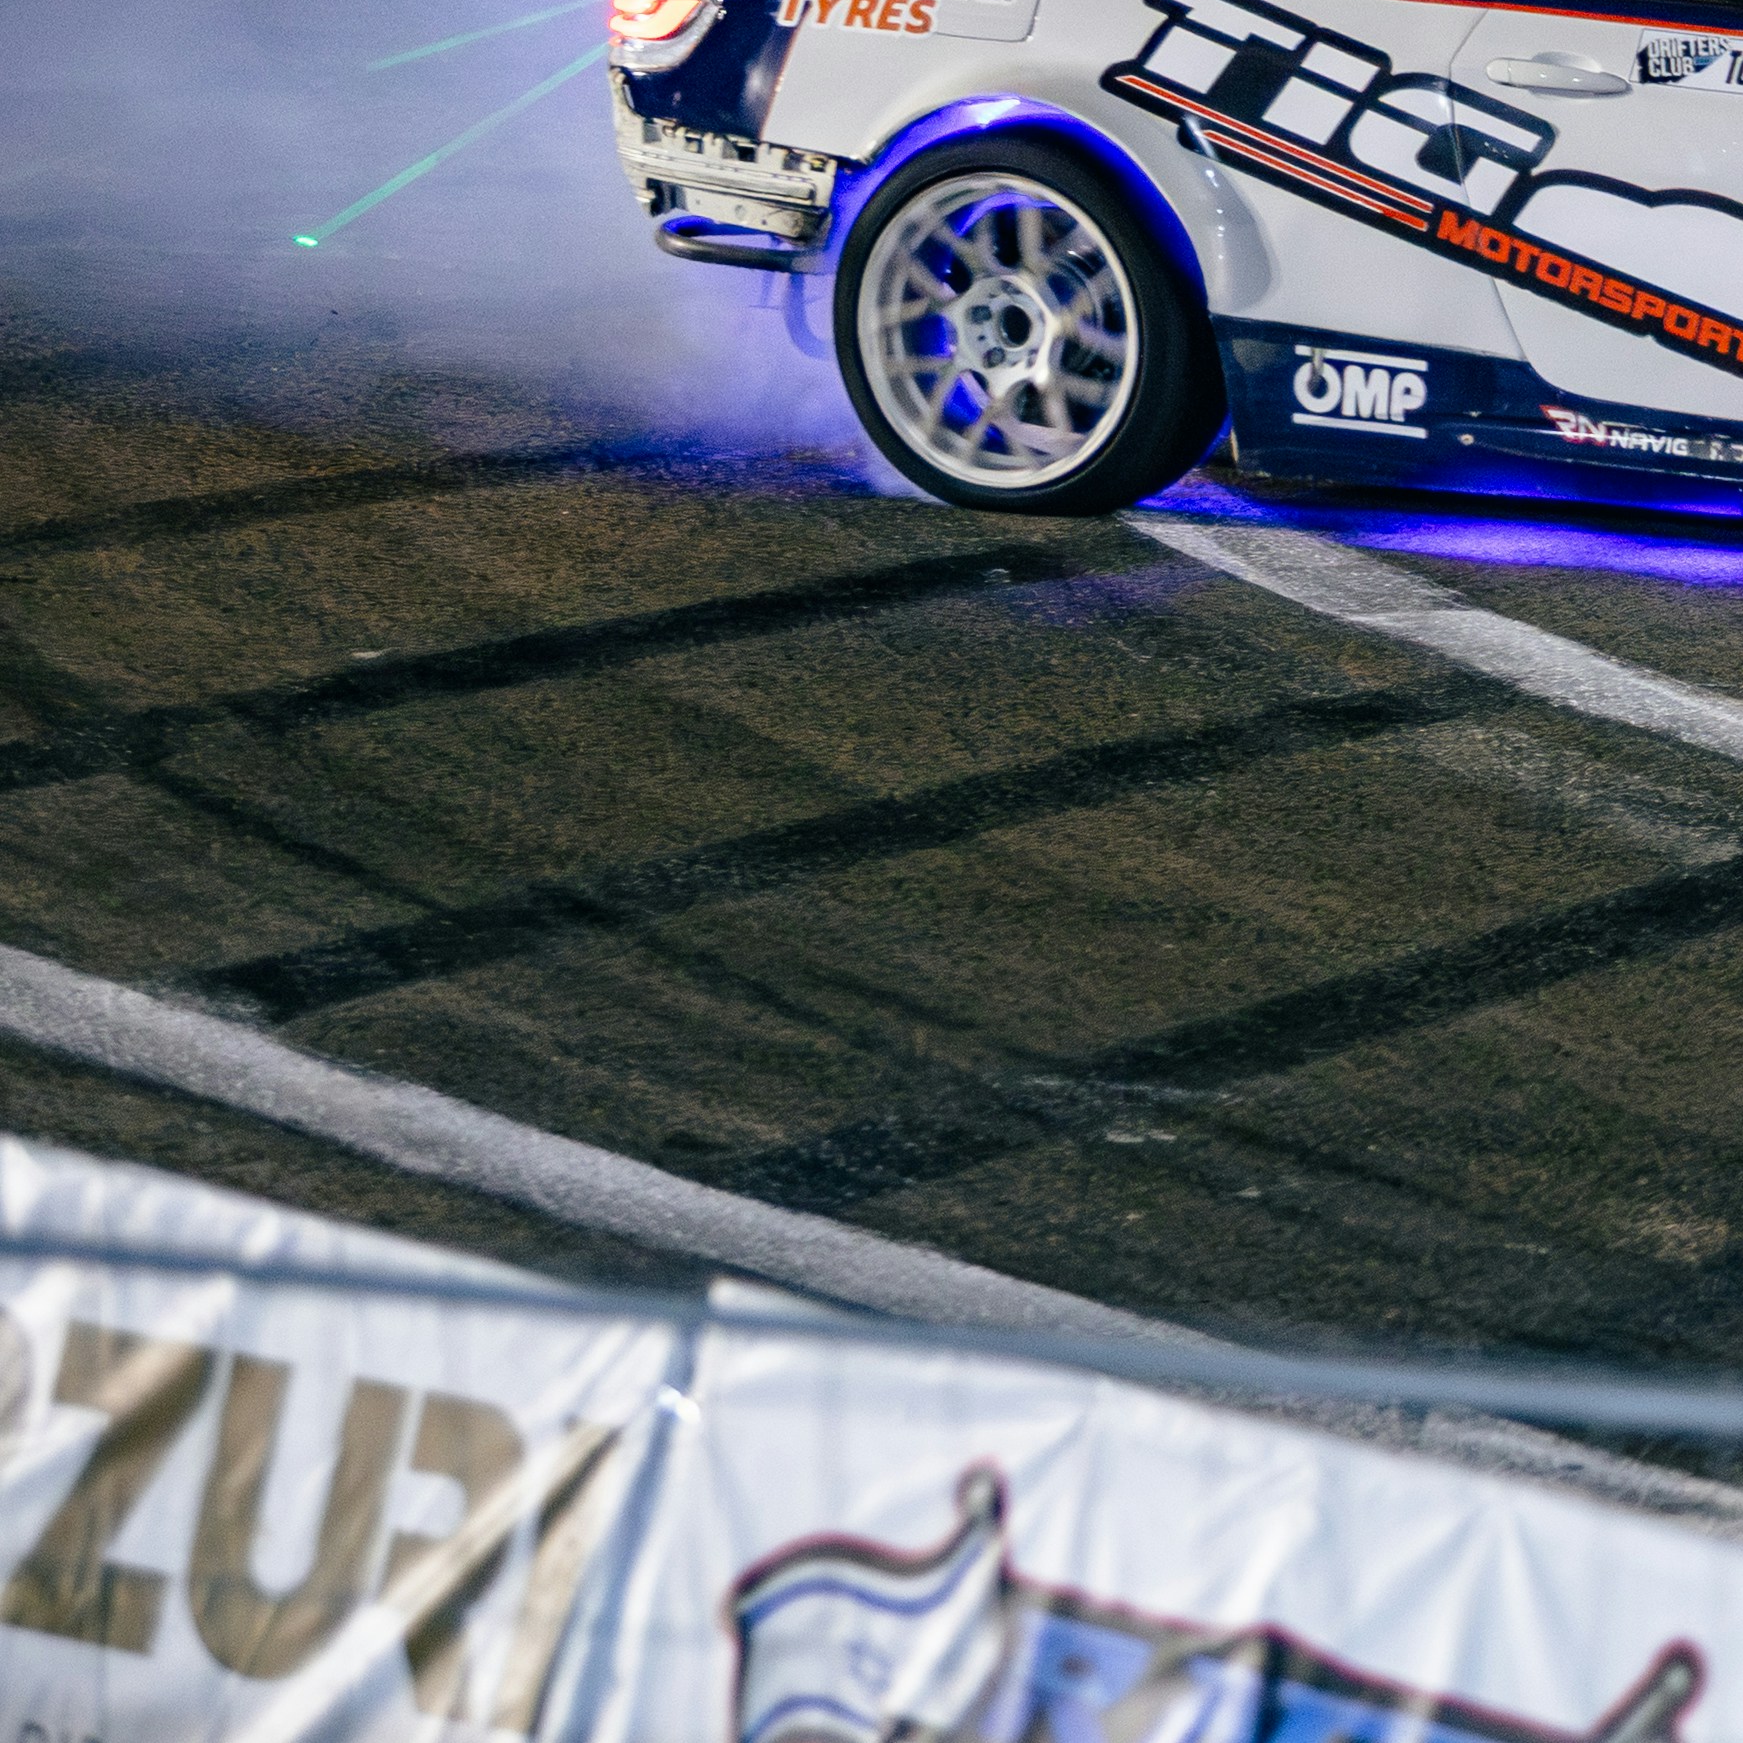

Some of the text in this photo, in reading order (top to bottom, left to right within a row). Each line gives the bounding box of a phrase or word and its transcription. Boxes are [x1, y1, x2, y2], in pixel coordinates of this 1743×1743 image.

[1649, 34, 1734, 58] DRIFTERS
[1648, 55, 1695, 79] CLUB
[1293, 361, 1428, 423] OMP
